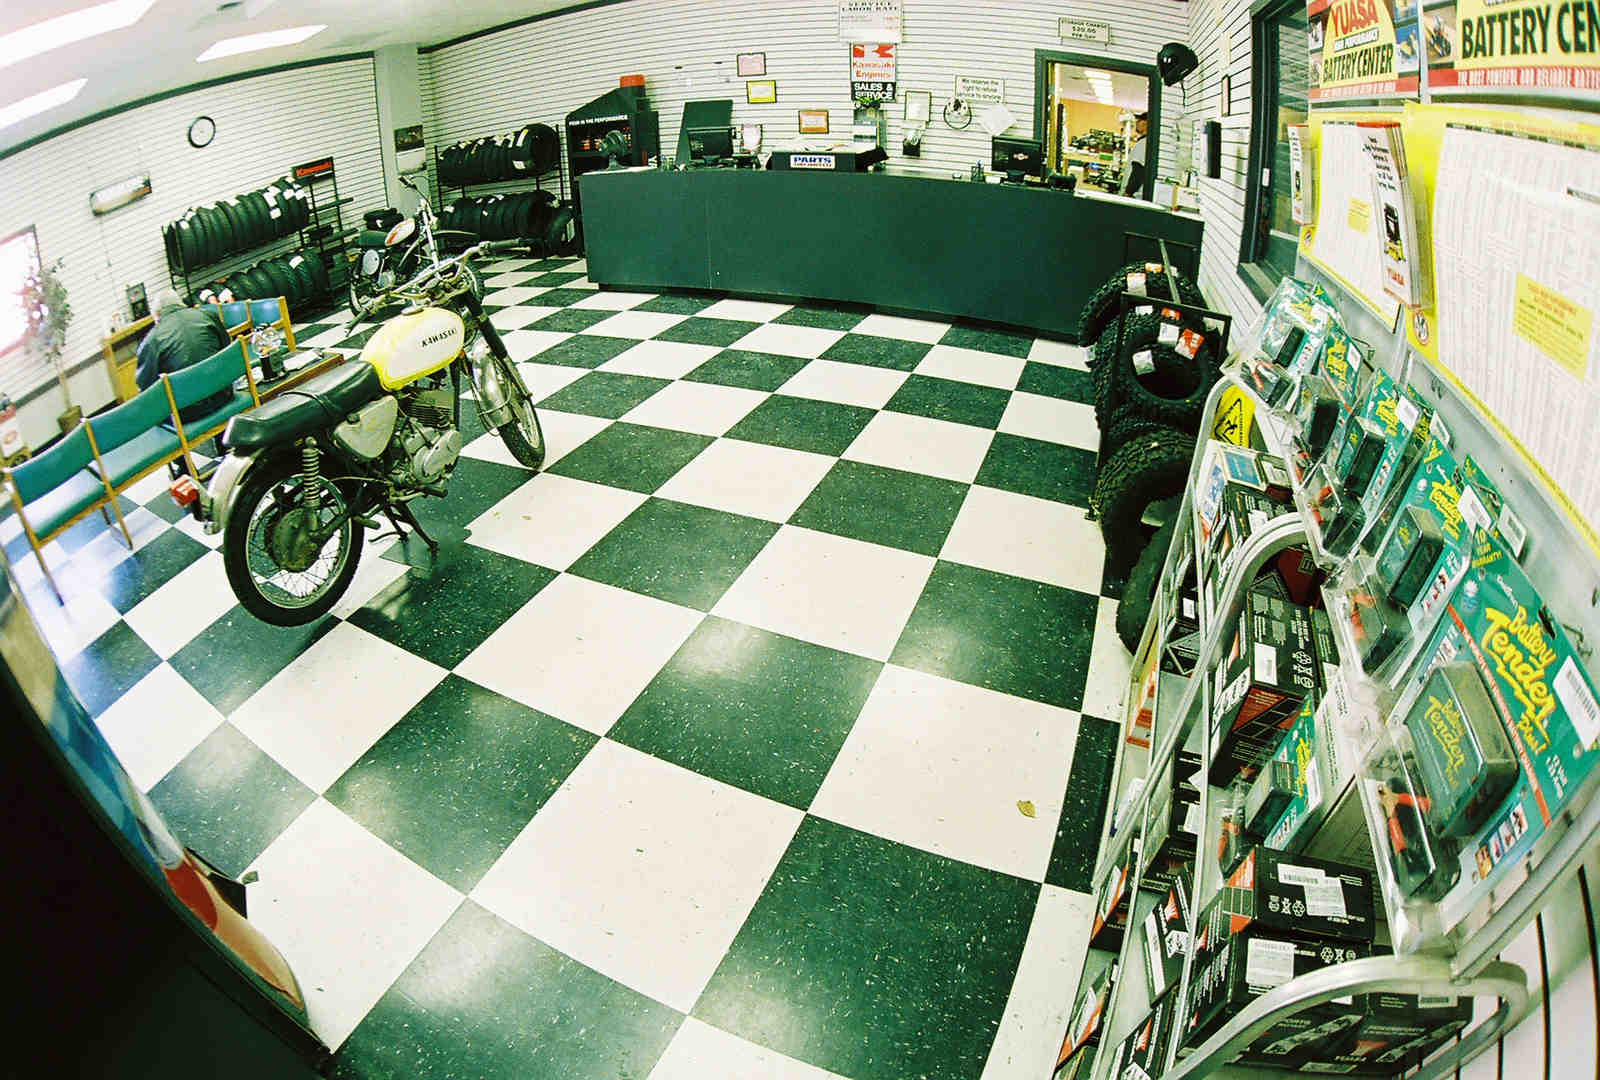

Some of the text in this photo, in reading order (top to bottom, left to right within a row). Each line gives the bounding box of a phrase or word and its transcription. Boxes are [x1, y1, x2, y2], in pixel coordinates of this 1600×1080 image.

[1330, 0, 1379, 37] YUASA
[1462, 4, 1550, 59] BATTERY
[1323, 43, 1394, 83] BATTERY CENTER
[855, 91, 893, 100] SERVICE
[1508, 605, 1557, 669] Battery
[1481, 607, 1555, 730] Tender
